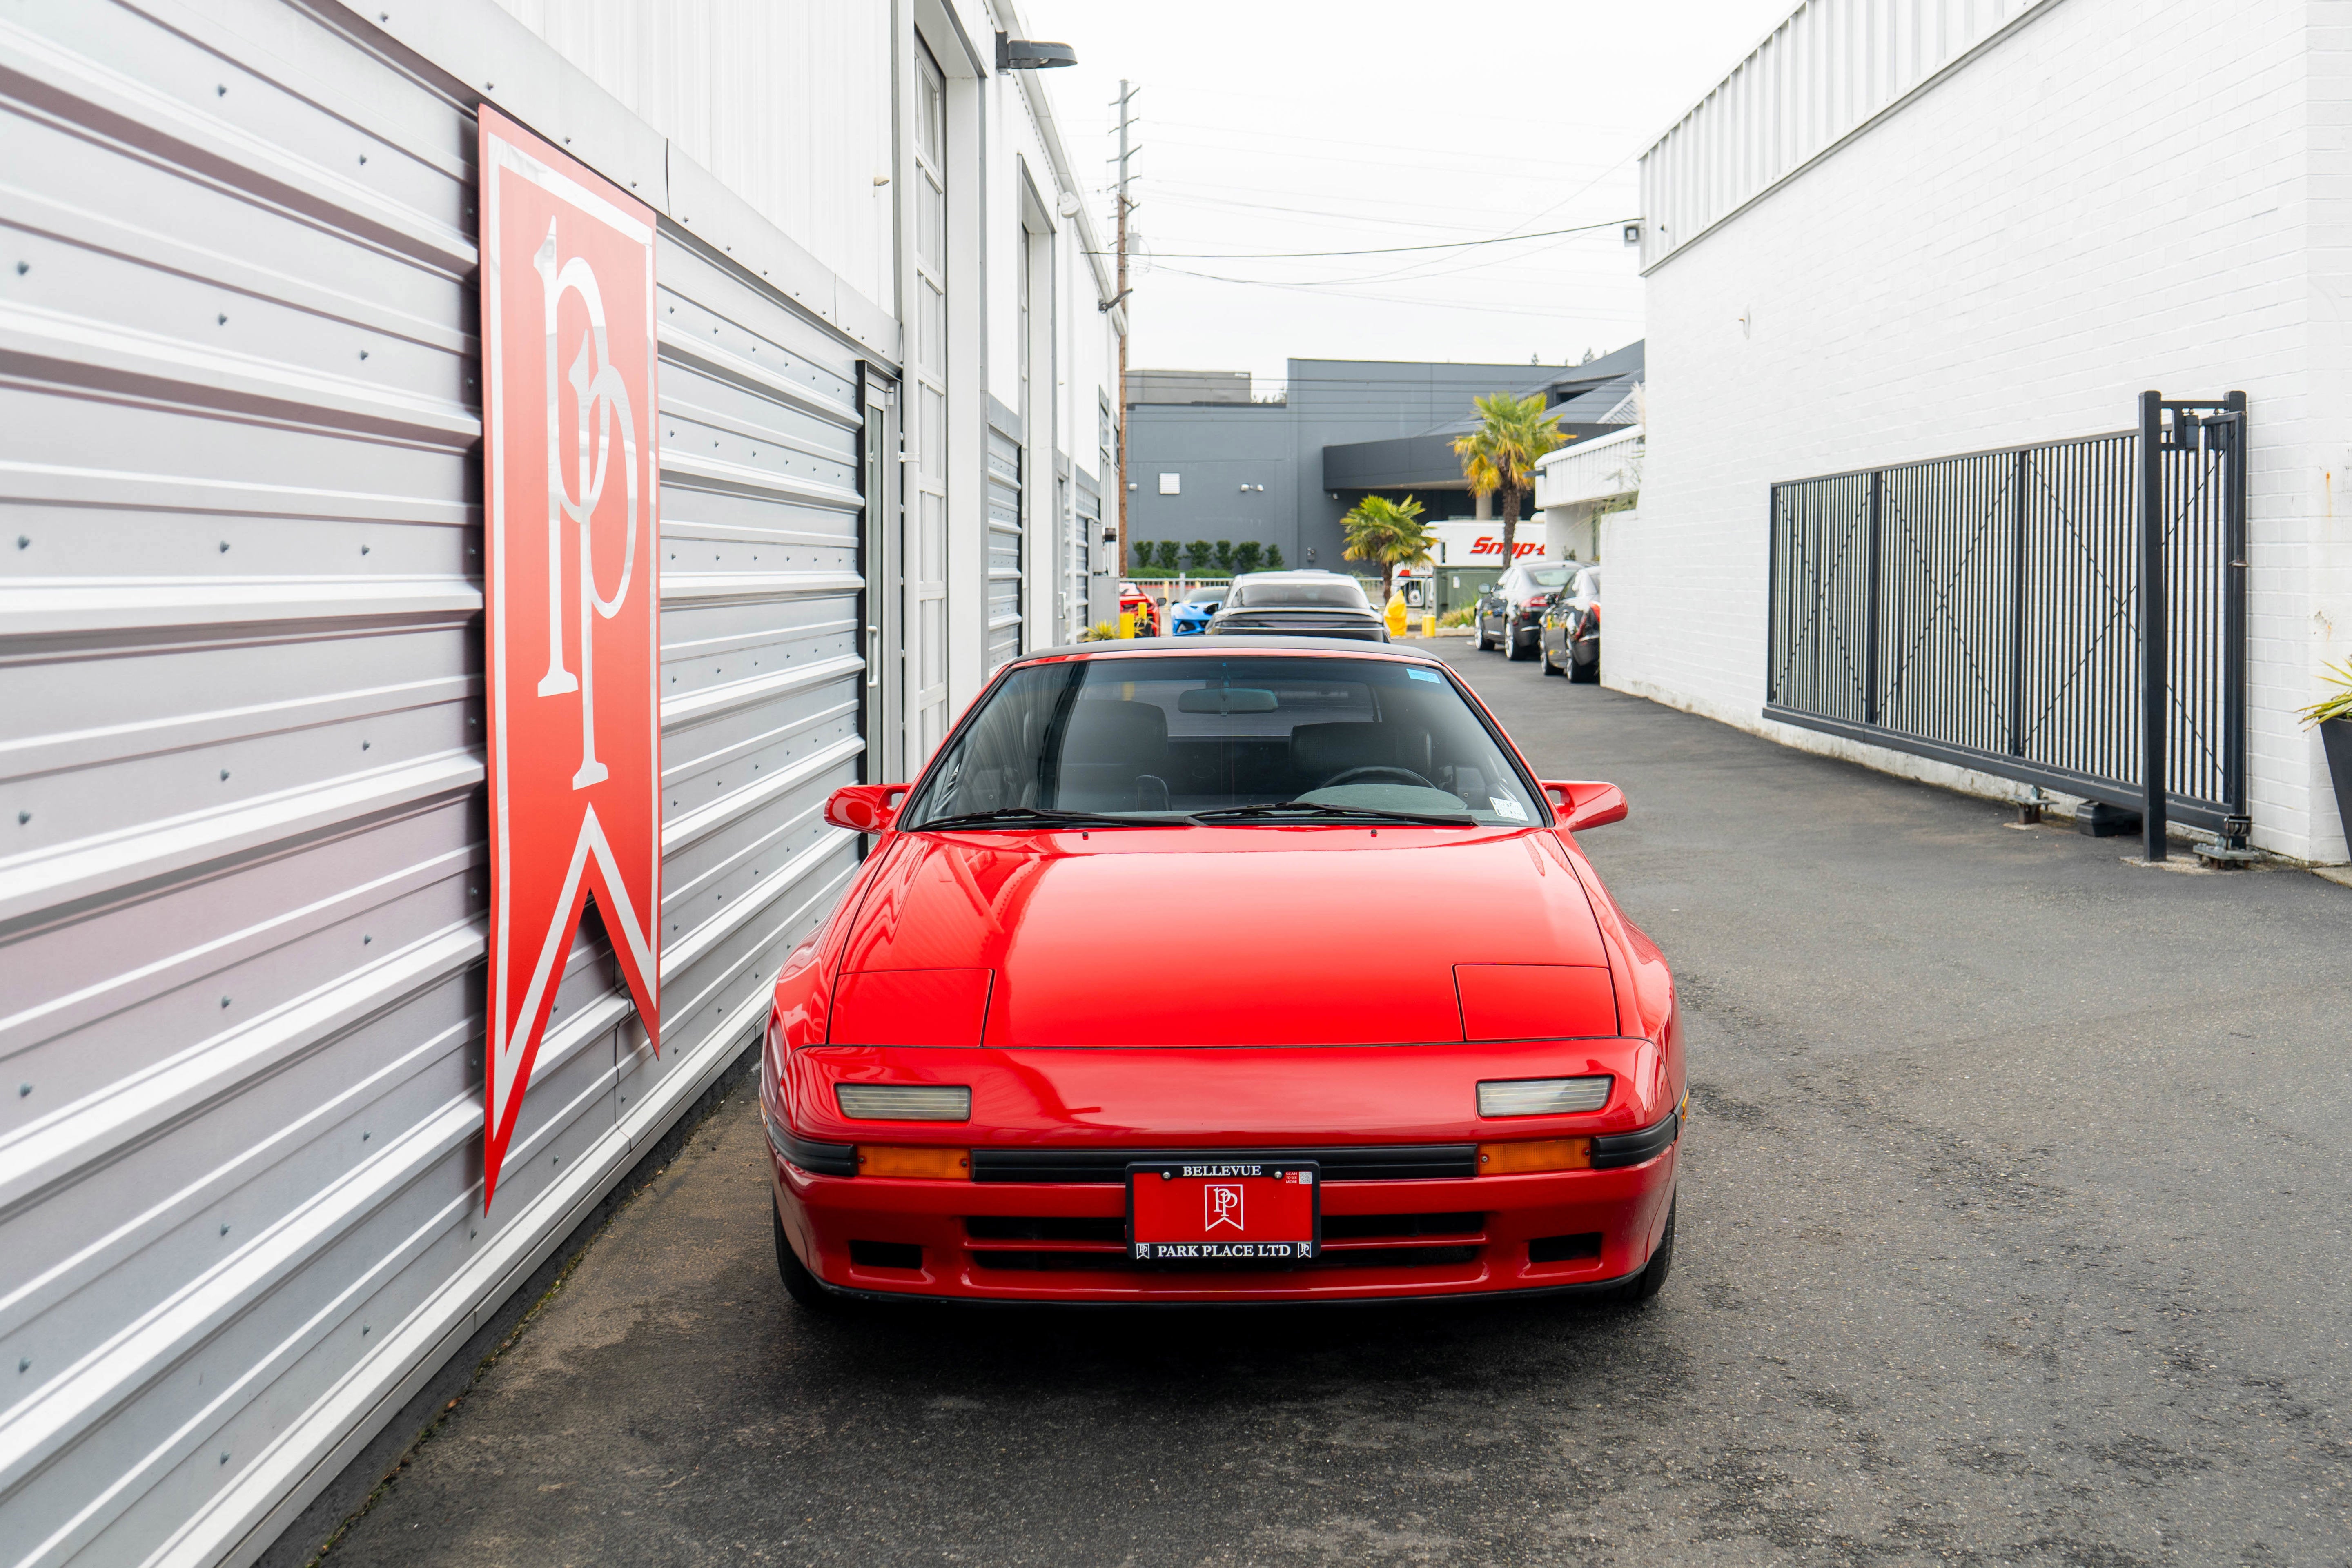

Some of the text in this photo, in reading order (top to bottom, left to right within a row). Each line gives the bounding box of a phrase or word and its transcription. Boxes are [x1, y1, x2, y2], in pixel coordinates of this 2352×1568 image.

[1183, 1165, 1261, 1176] BELLEVUE
[1157, 1244, 1291, 1257] PARK PLACE LTD
